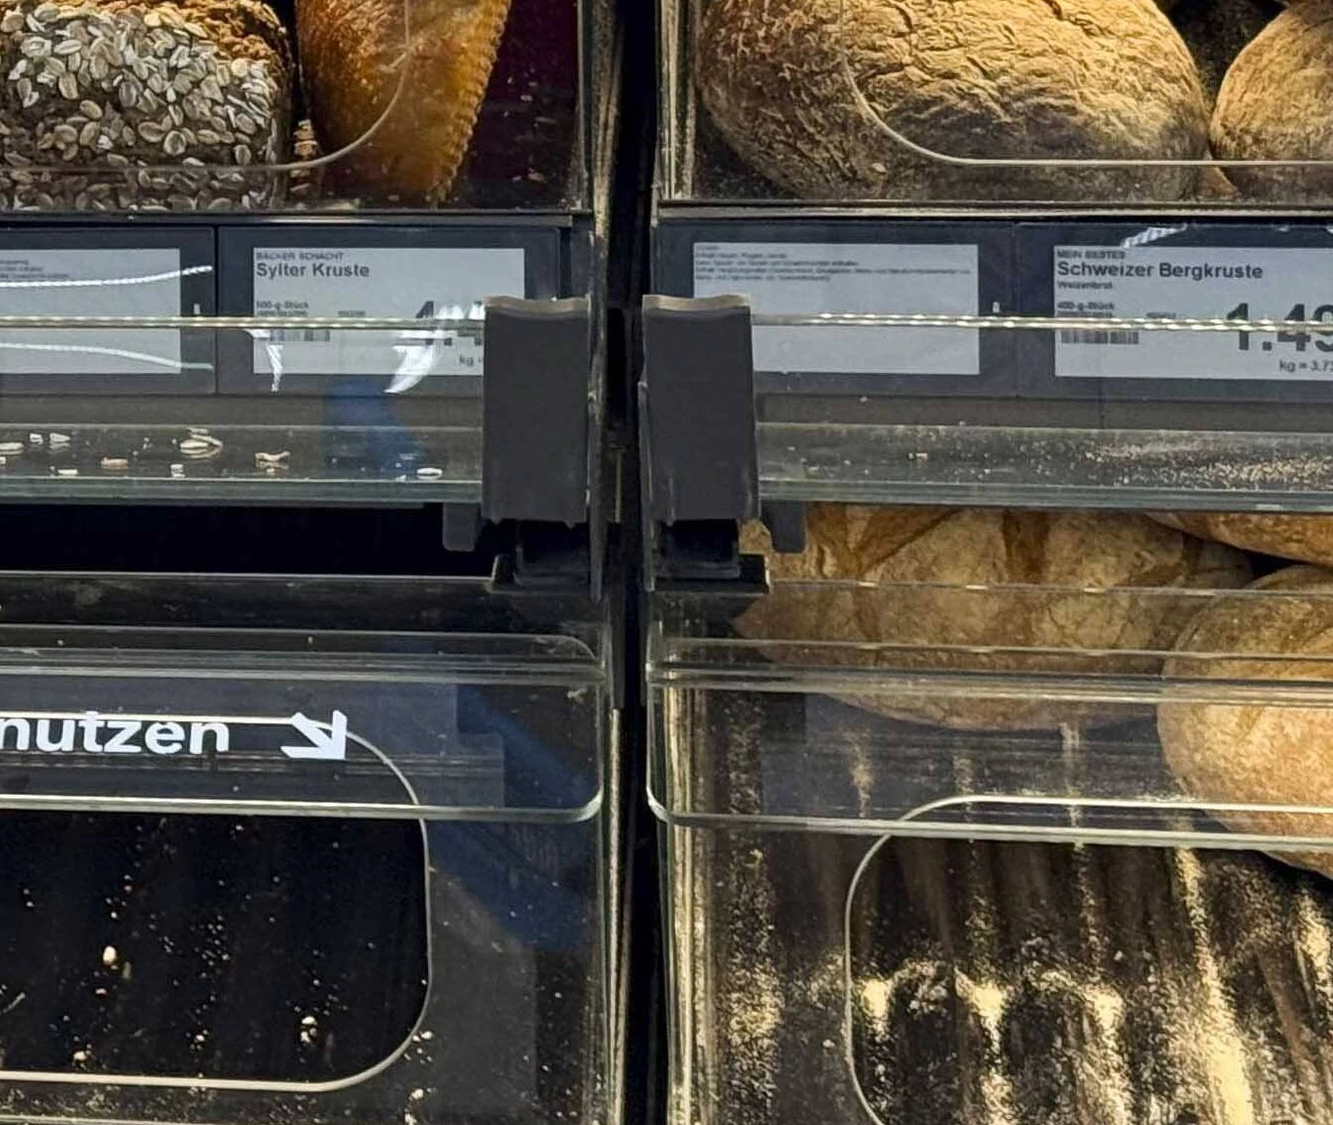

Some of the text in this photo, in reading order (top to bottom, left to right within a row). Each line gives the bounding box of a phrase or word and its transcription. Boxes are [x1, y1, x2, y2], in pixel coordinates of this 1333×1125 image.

[256, 263, 370, 280] Sylter Kruste
[1057, 261, 1264, 281] Schweizer Bergkruste
[1279, 360, 1296, 372] kg
